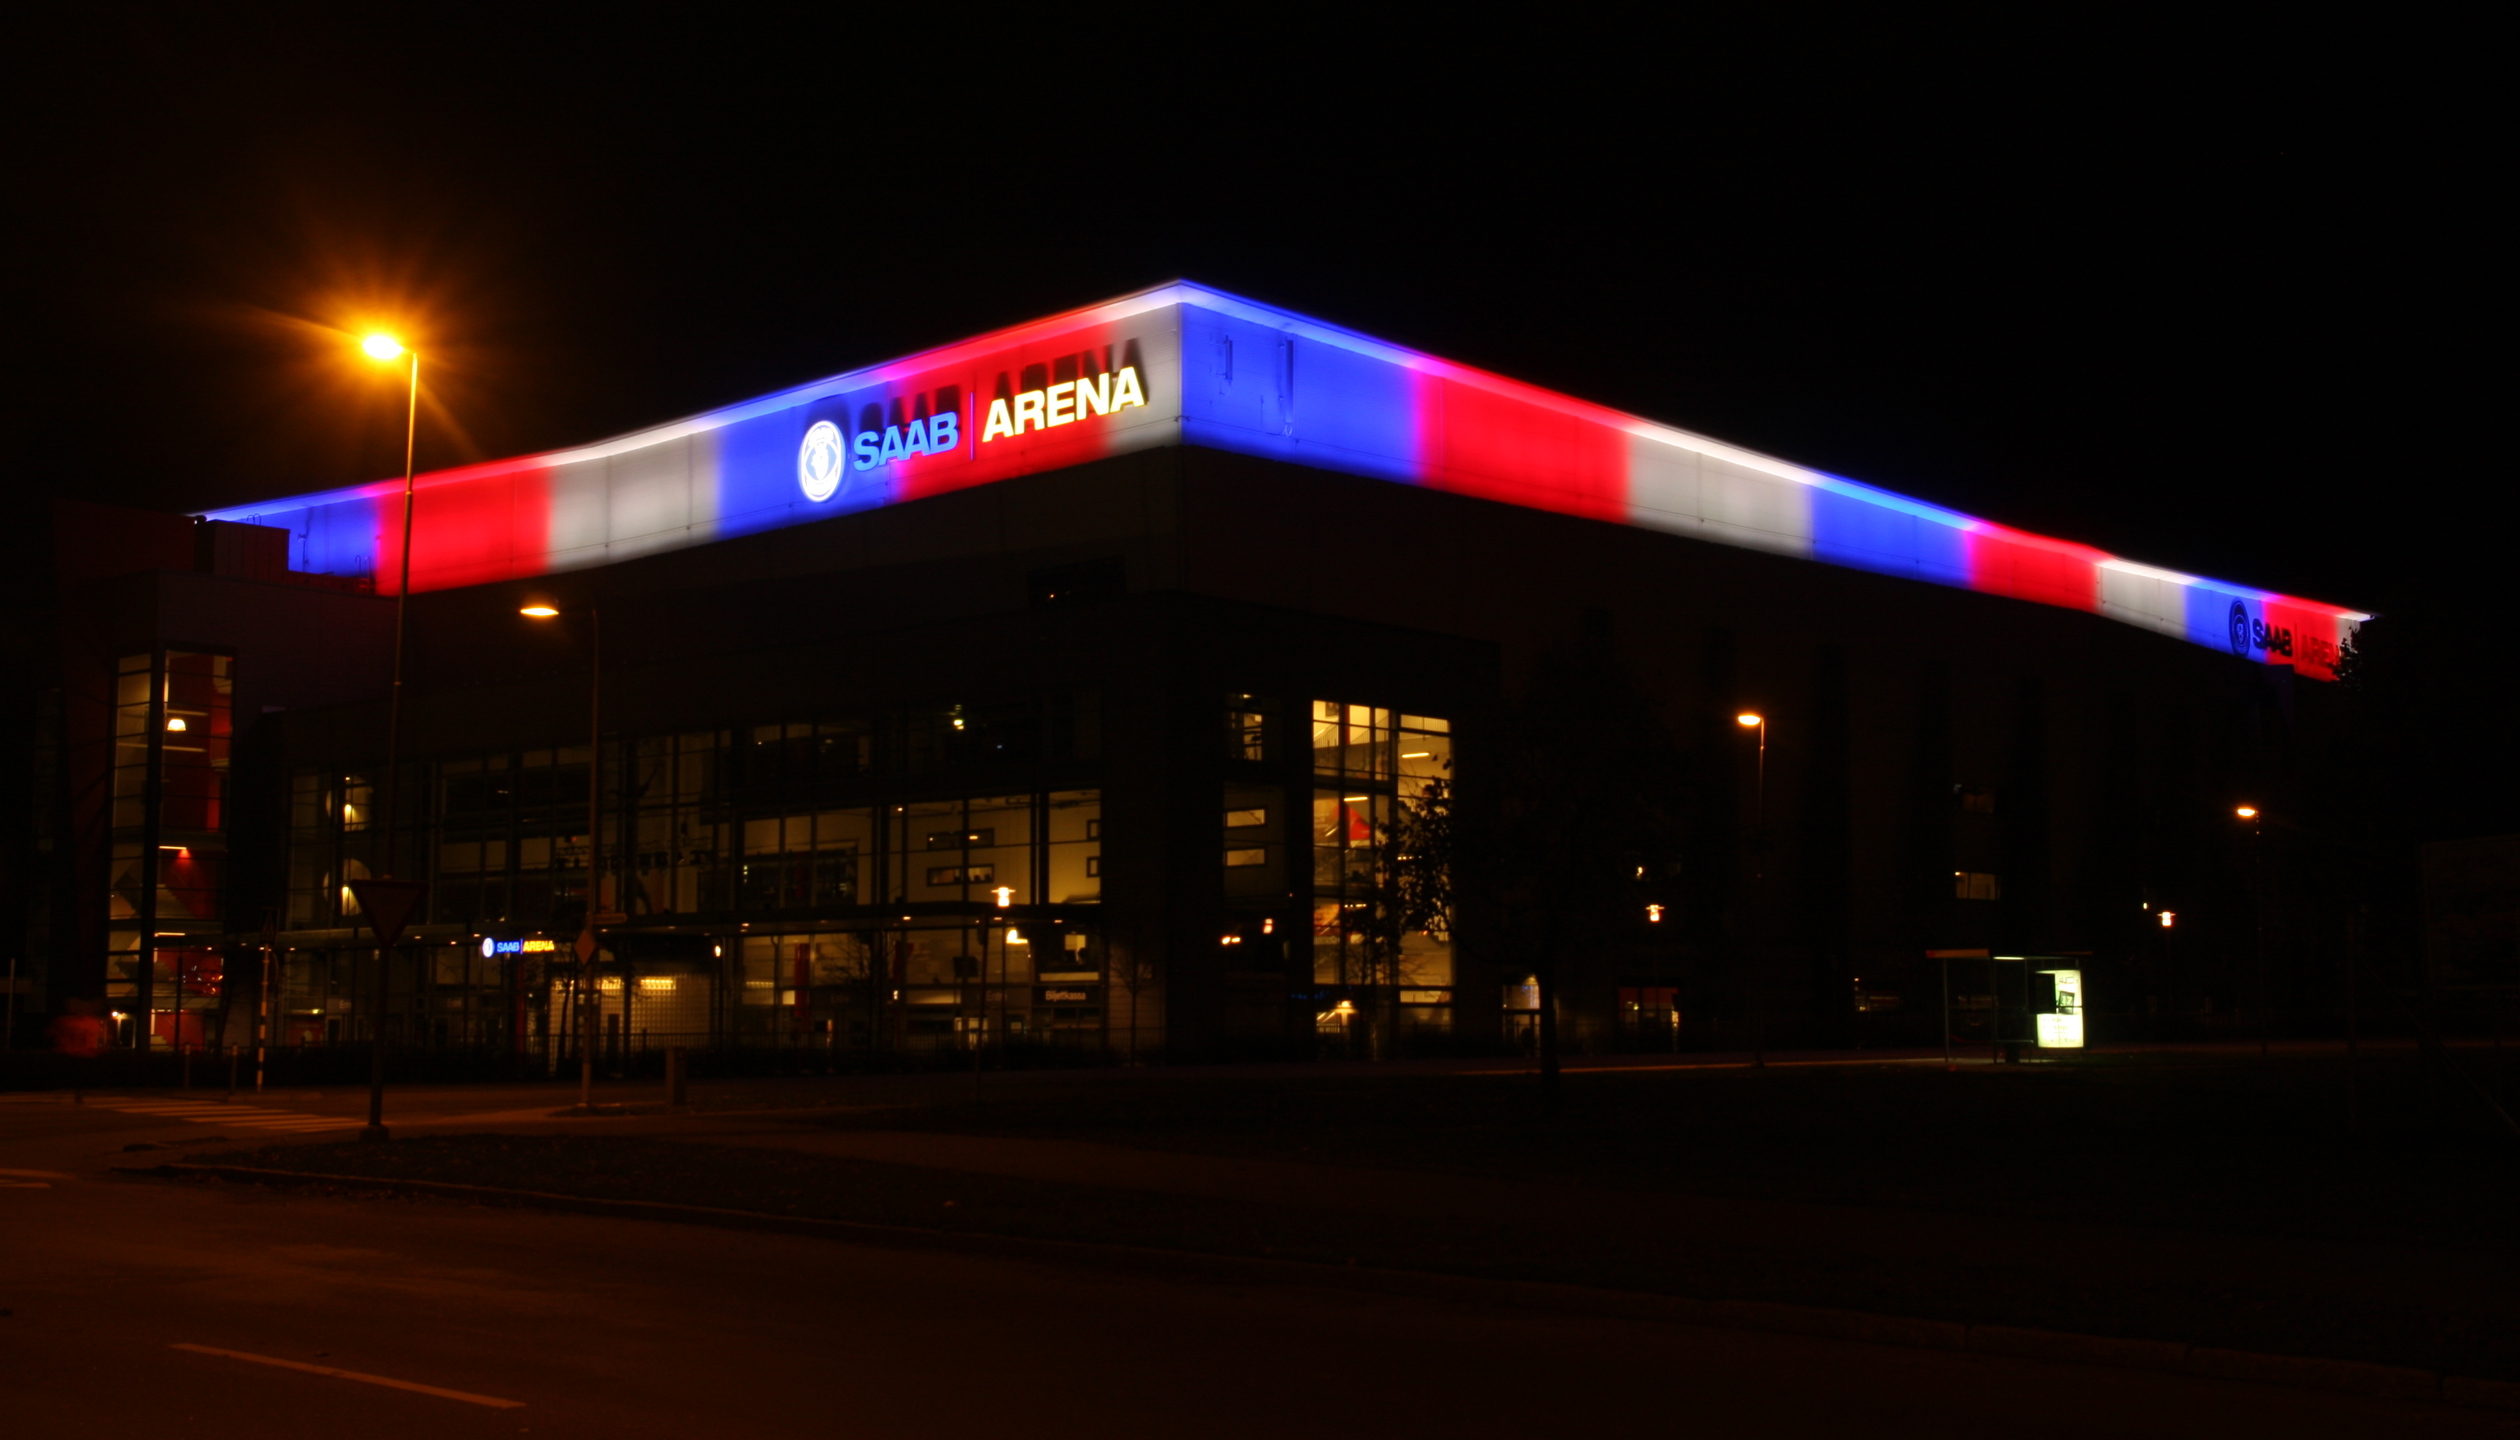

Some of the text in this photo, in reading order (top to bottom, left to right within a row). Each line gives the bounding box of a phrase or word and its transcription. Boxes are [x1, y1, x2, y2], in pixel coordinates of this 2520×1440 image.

[853, 366, 1145, 471] SAAB ARENA
[2252, 618, 2293, 657] SAAB
[496, 940, 555, 953] SAAB ARENA
